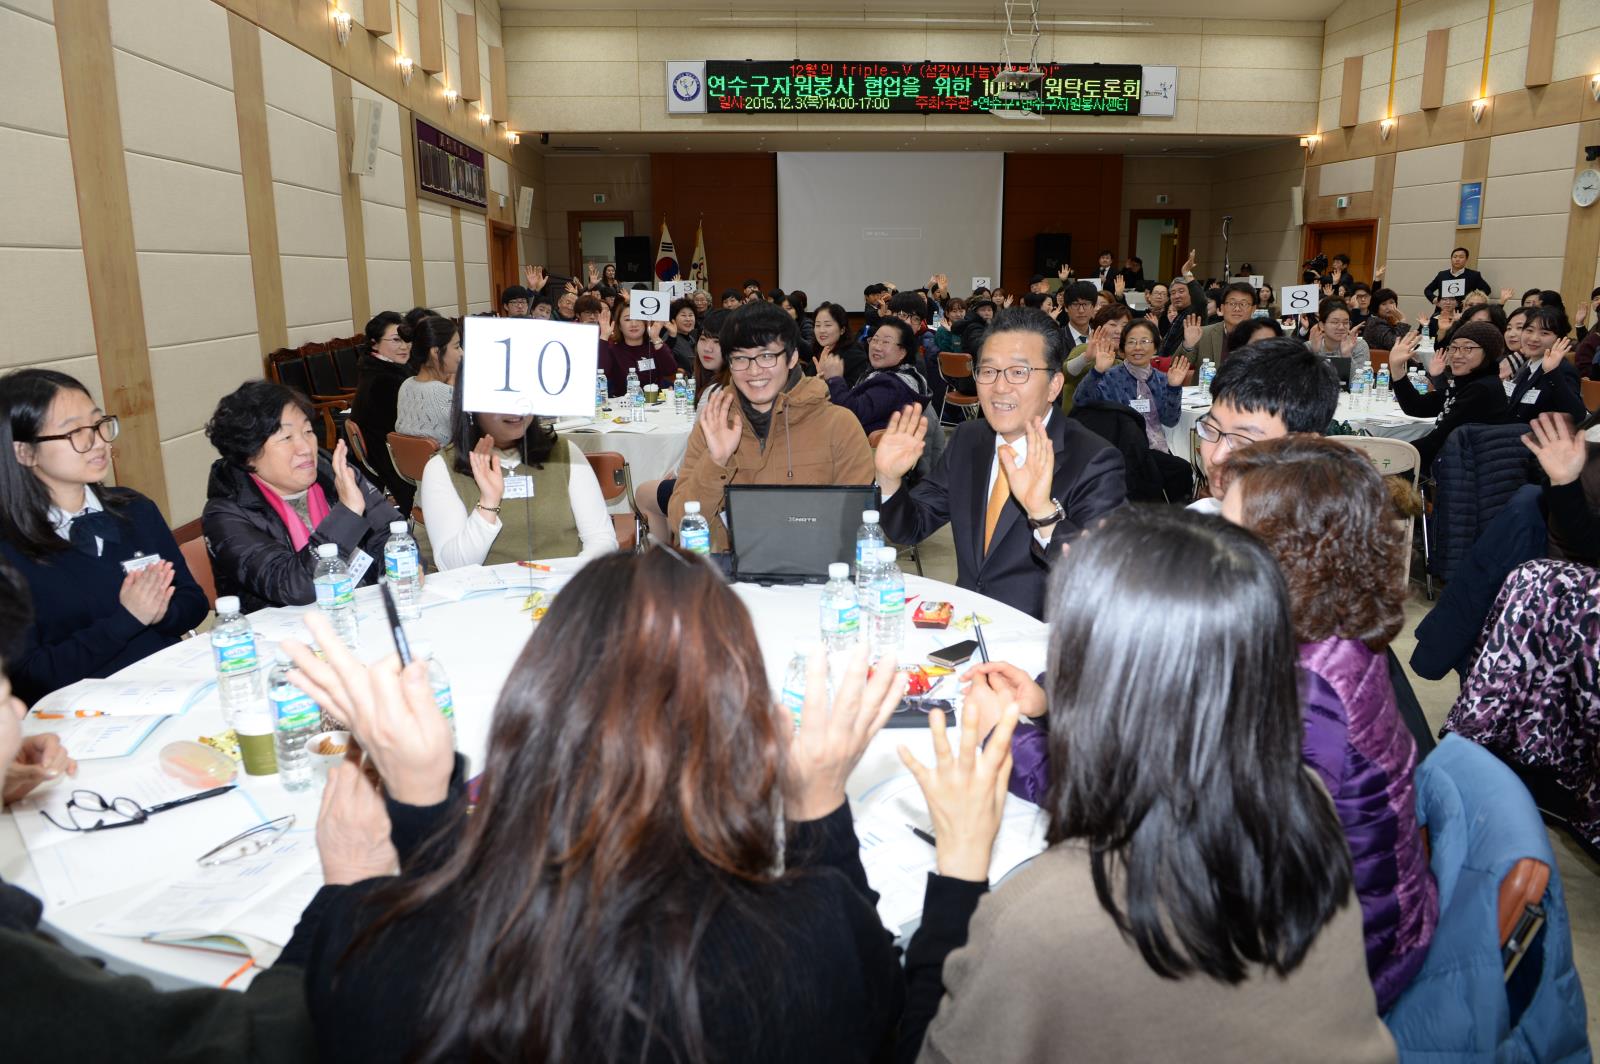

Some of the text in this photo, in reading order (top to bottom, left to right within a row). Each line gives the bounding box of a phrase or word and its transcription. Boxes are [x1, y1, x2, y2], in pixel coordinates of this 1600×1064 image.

[707, 76, 855, 97] 연수구자원봉사
[864, 77, 921, 97] 협업을
[932, 77, 972, 97] 위한
[1044, 78, 1140, 99] 원탁토론회
[1447, 283, 1460, 294] 6
[639, 296, 662, 316] 9
[1290, 290, 1310, 309] 8
[494, 337, 571, 396] 10
